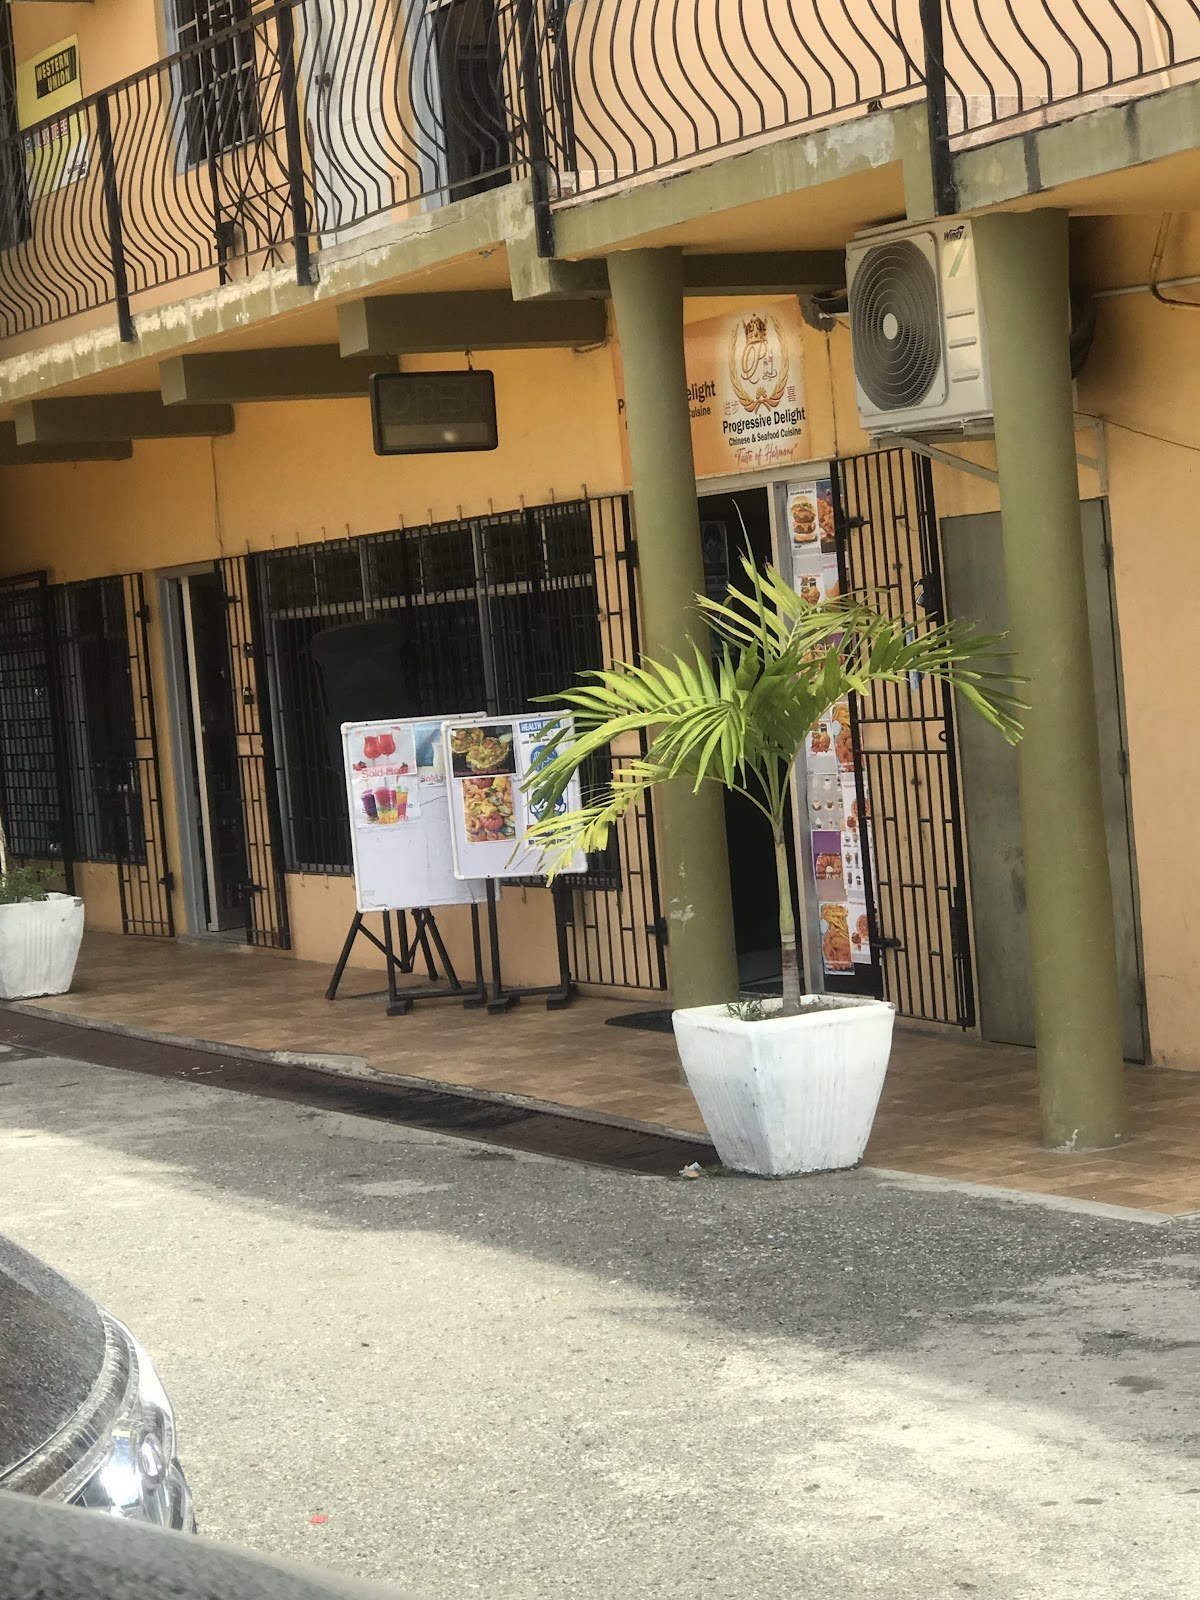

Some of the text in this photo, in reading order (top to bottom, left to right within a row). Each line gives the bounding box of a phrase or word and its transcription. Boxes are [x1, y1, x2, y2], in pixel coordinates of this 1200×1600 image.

[36, 52, 70, 81] WESTERN
[47, 68, 70, 92] UNION
[944, 226, 964, 241] Windy
[687, 380, 716, 403] elight
[688, 405, 711, 418] uisine
[723, 407, 806, 434] Progressive Delight
[728, 427, 802, 446] Chinese & Seafood Cuisine
[755, 448, 762, 465] of
[520, 721, 542, 732] HEALTH
